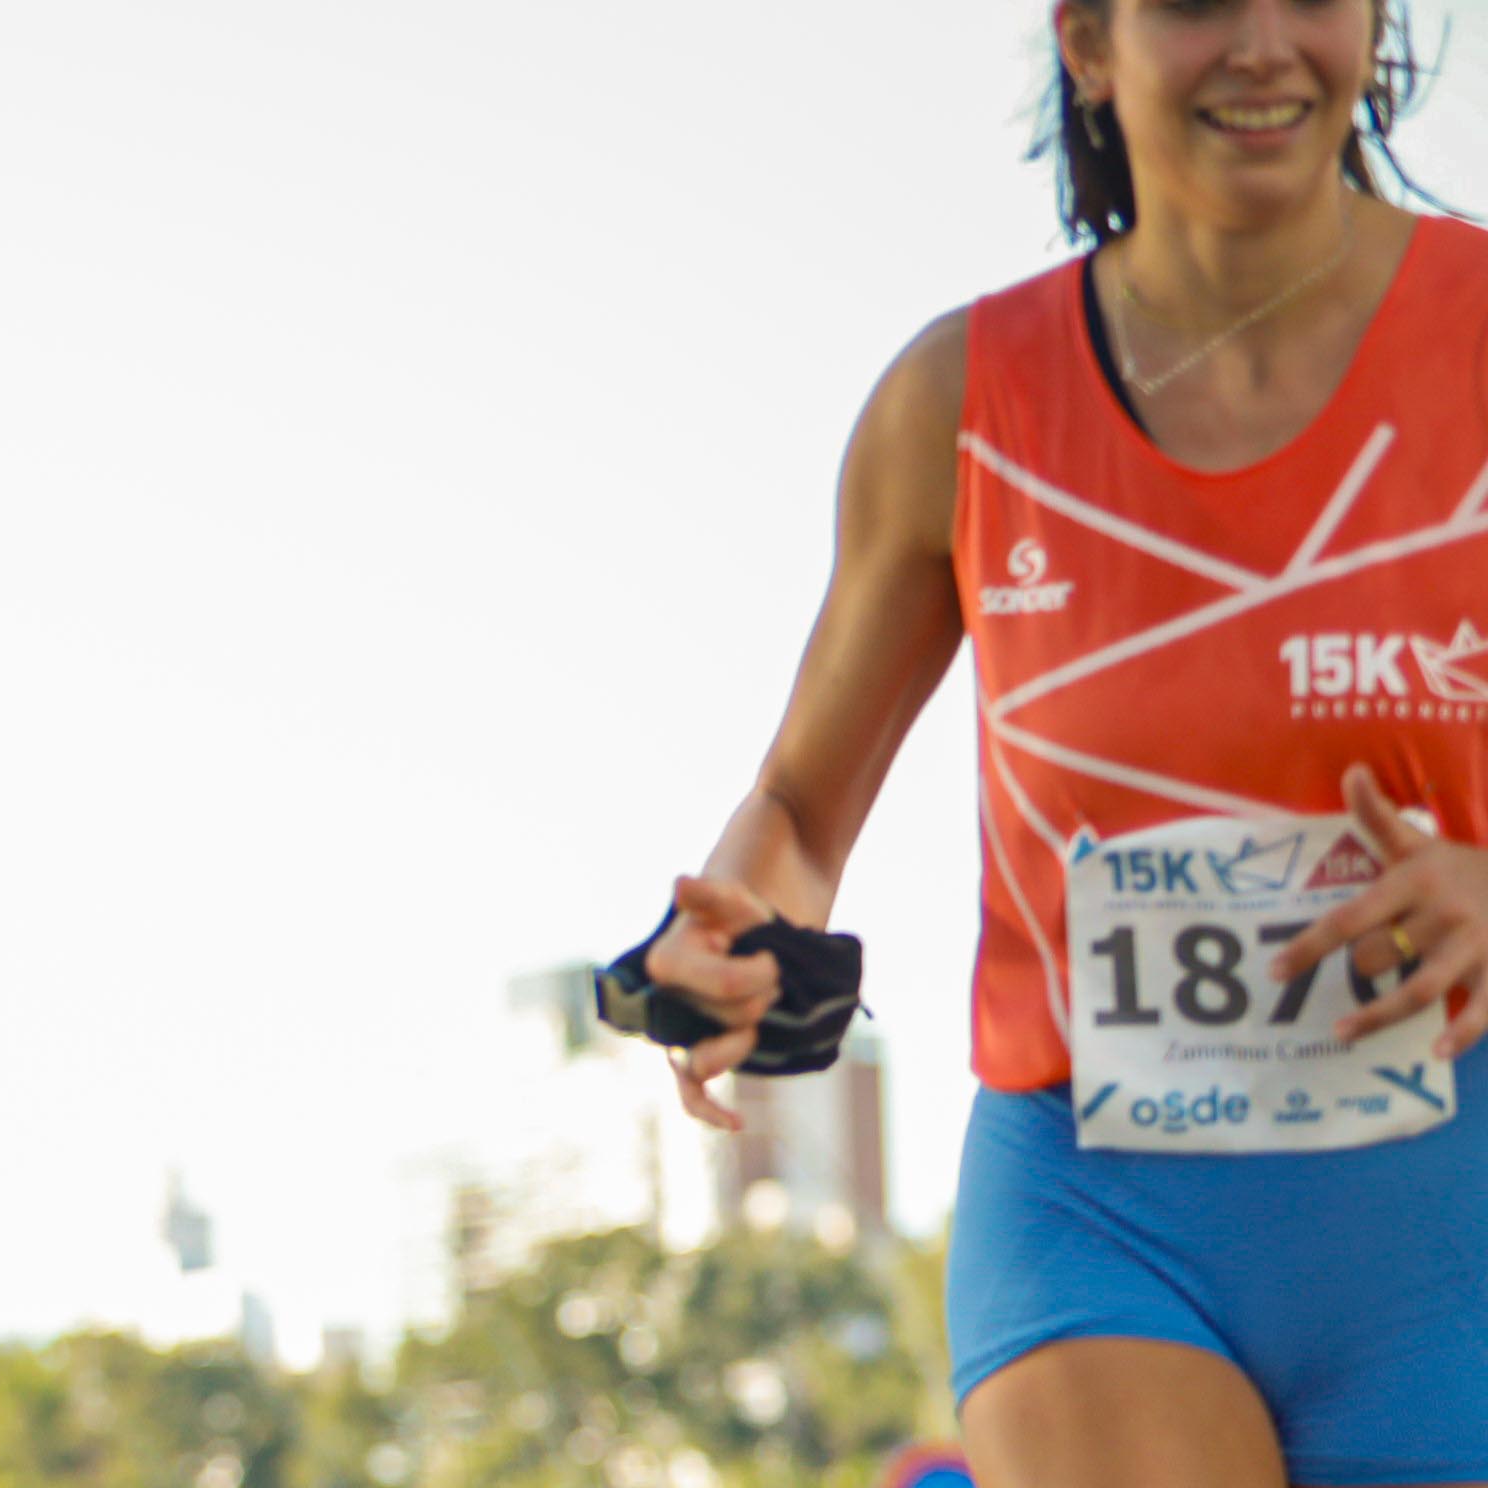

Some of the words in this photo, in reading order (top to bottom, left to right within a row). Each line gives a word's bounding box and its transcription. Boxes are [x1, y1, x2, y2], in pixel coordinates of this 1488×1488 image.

[1279, 633, 1409, 697] 15K
[1104, 850, 1198, 893] 15K
[1130, 1085, 1249, 1133] osde
